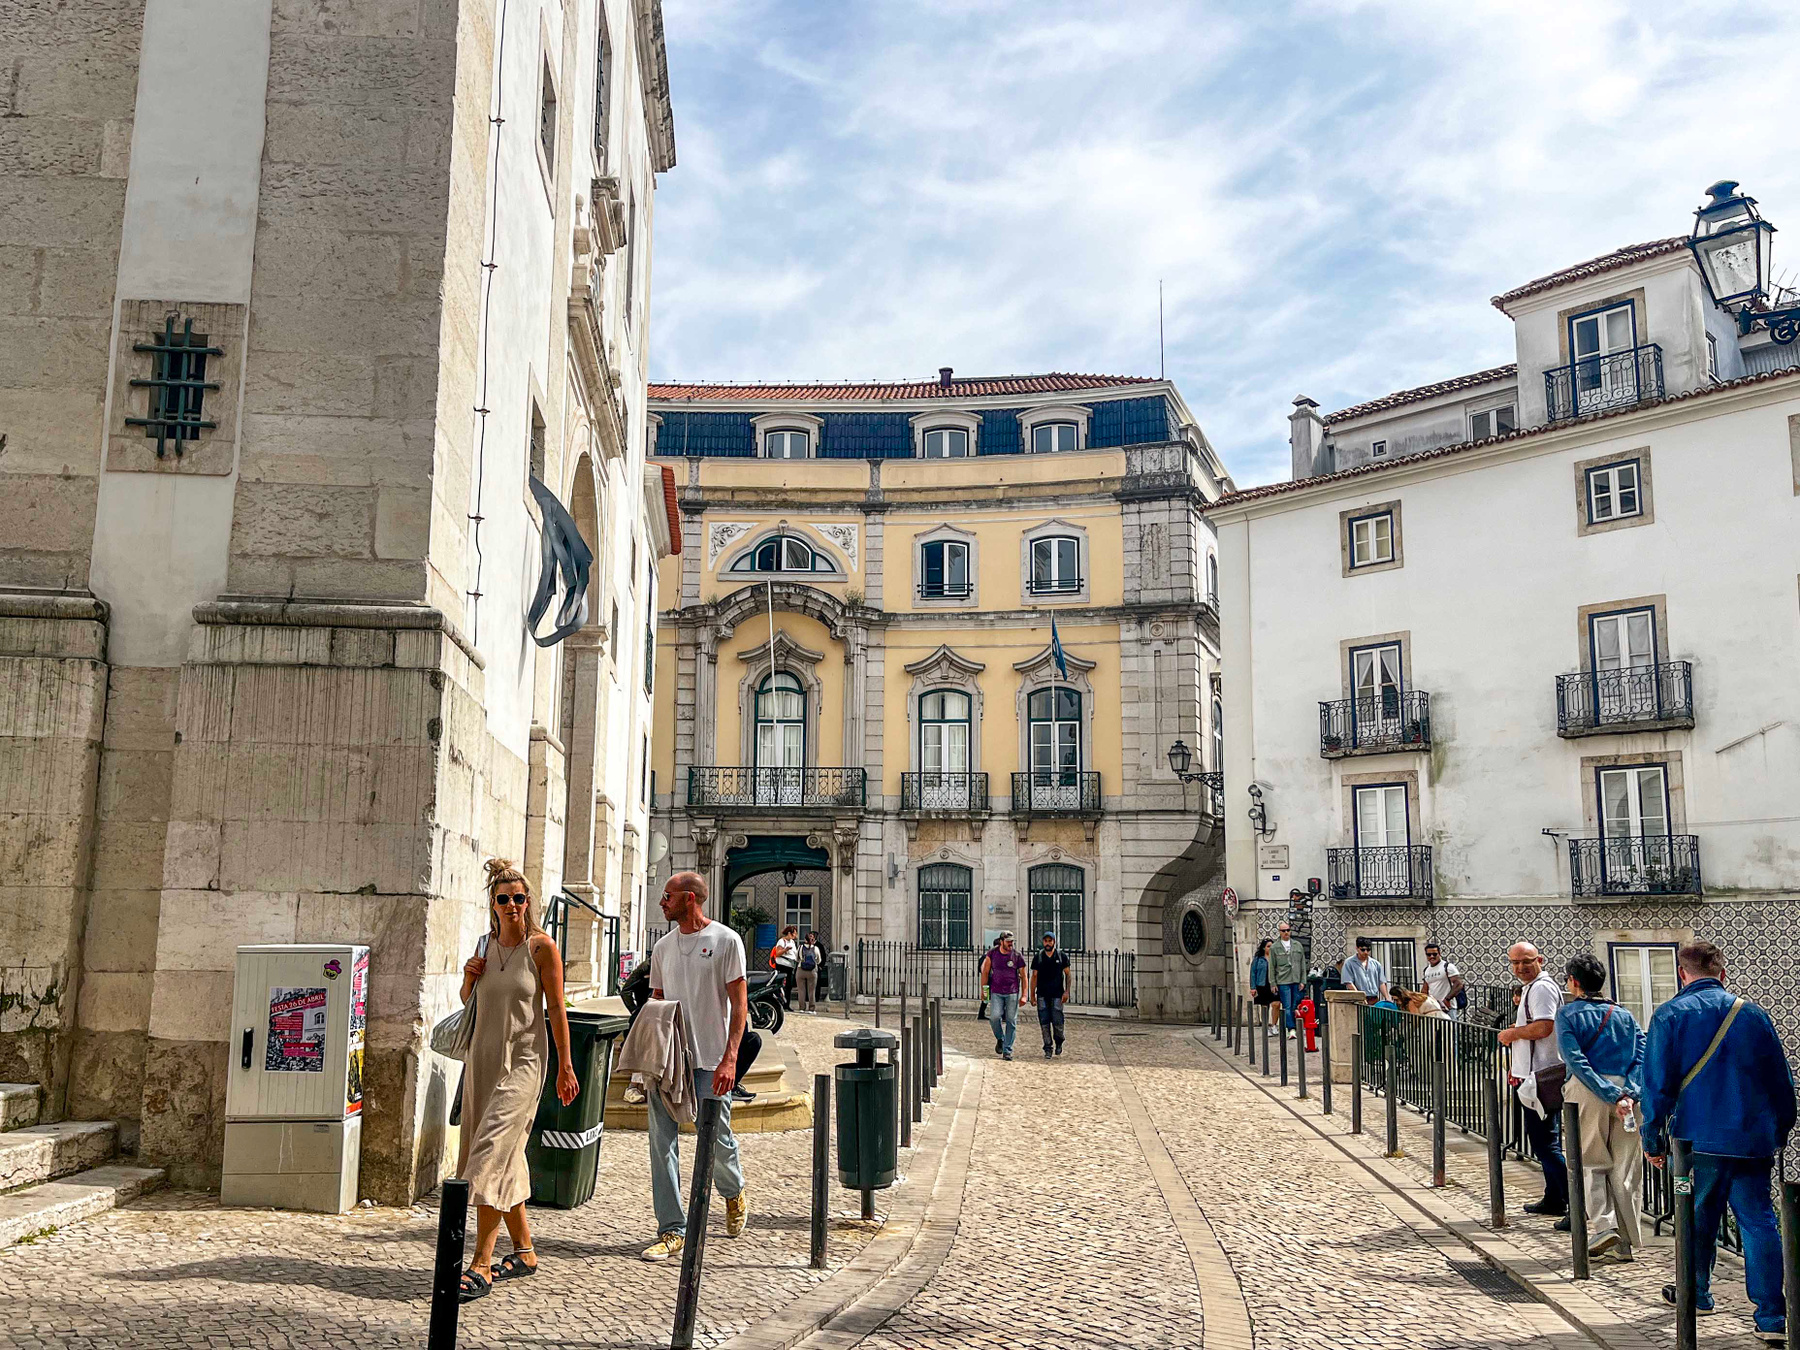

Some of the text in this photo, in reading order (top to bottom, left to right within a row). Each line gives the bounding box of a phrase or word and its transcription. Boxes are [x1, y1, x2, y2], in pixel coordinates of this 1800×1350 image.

[271, 1003, 288, 1013] FESTA
[288, 1001, 298, 1009] 26
[307, 994, 325, 1003] ABRIL
